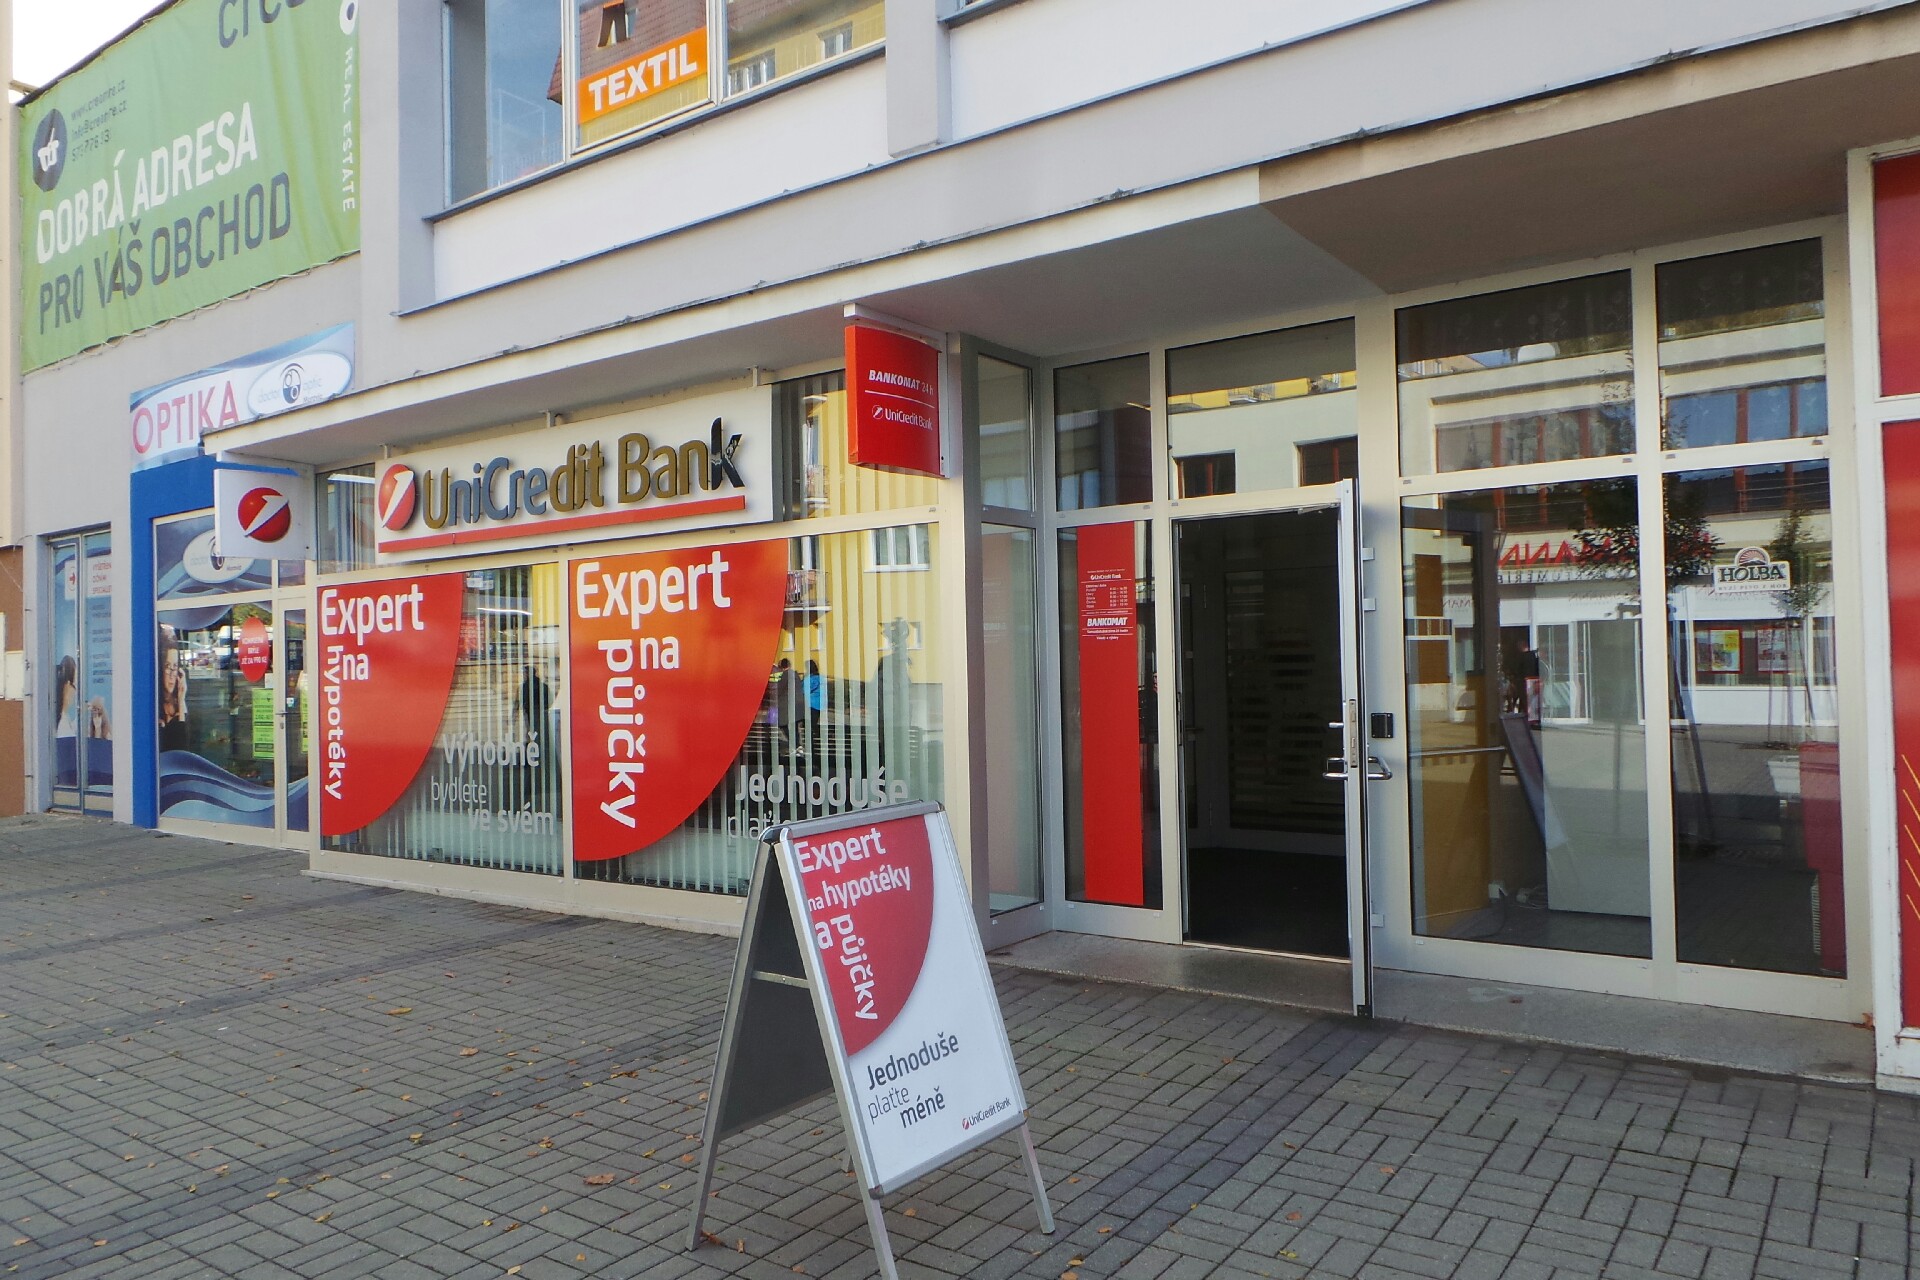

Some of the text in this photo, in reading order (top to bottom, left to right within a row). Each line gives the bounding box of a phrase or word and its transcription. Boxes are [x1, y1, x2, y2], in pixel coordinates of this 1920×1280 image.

[588, 42, 697, 111] TEXTIL
[342, 47, 355, 212] REAL ESTATE
[36, 101, 258, 264] DOBRÁ ADRESA
[39, 171, 292, 335] PRO VÁŠ OBCHOD
[868, 369, 920, 391] BANKOMAT
[132, 380, 240, 454] OPTIKA
[885, 407, 933, 431] UniCredit Bank
[422, 416, 746, 530] UniCredit Bank
[576, 551, 732, 629] Expert
[1719, 565, 1784, 582] HOLBA
[321, 583, 424, 646] Expert
[1087, 616, 1128, 627] BANKOMAT
[342, 652, 369, 681] na
[640, 634, 680, 670] na
[323, 645, 347, 801] hypotéky
[598, 639, 646, 829] půjčky
[441, 731, 540, 773] Výhodně
[430, 775, 488, 806] bydlete
[735, 764, 909, 809] Jednoduše
[467, 802, 555, 836] ve svém
[793, 827, 886, 874] Expert
[808, 863, 911, 912] na hypotéky
[814, 921, 833, 950] a
[830, 913, 879, 1020] půjčky
[867, 1031, 960, 1091] Jednoduše
[867, 1084, 910, 1125] plaťte
[899, 1085, 946, 1129] méně
[967, 1096, 1012, 1128] UniCredit Bank
